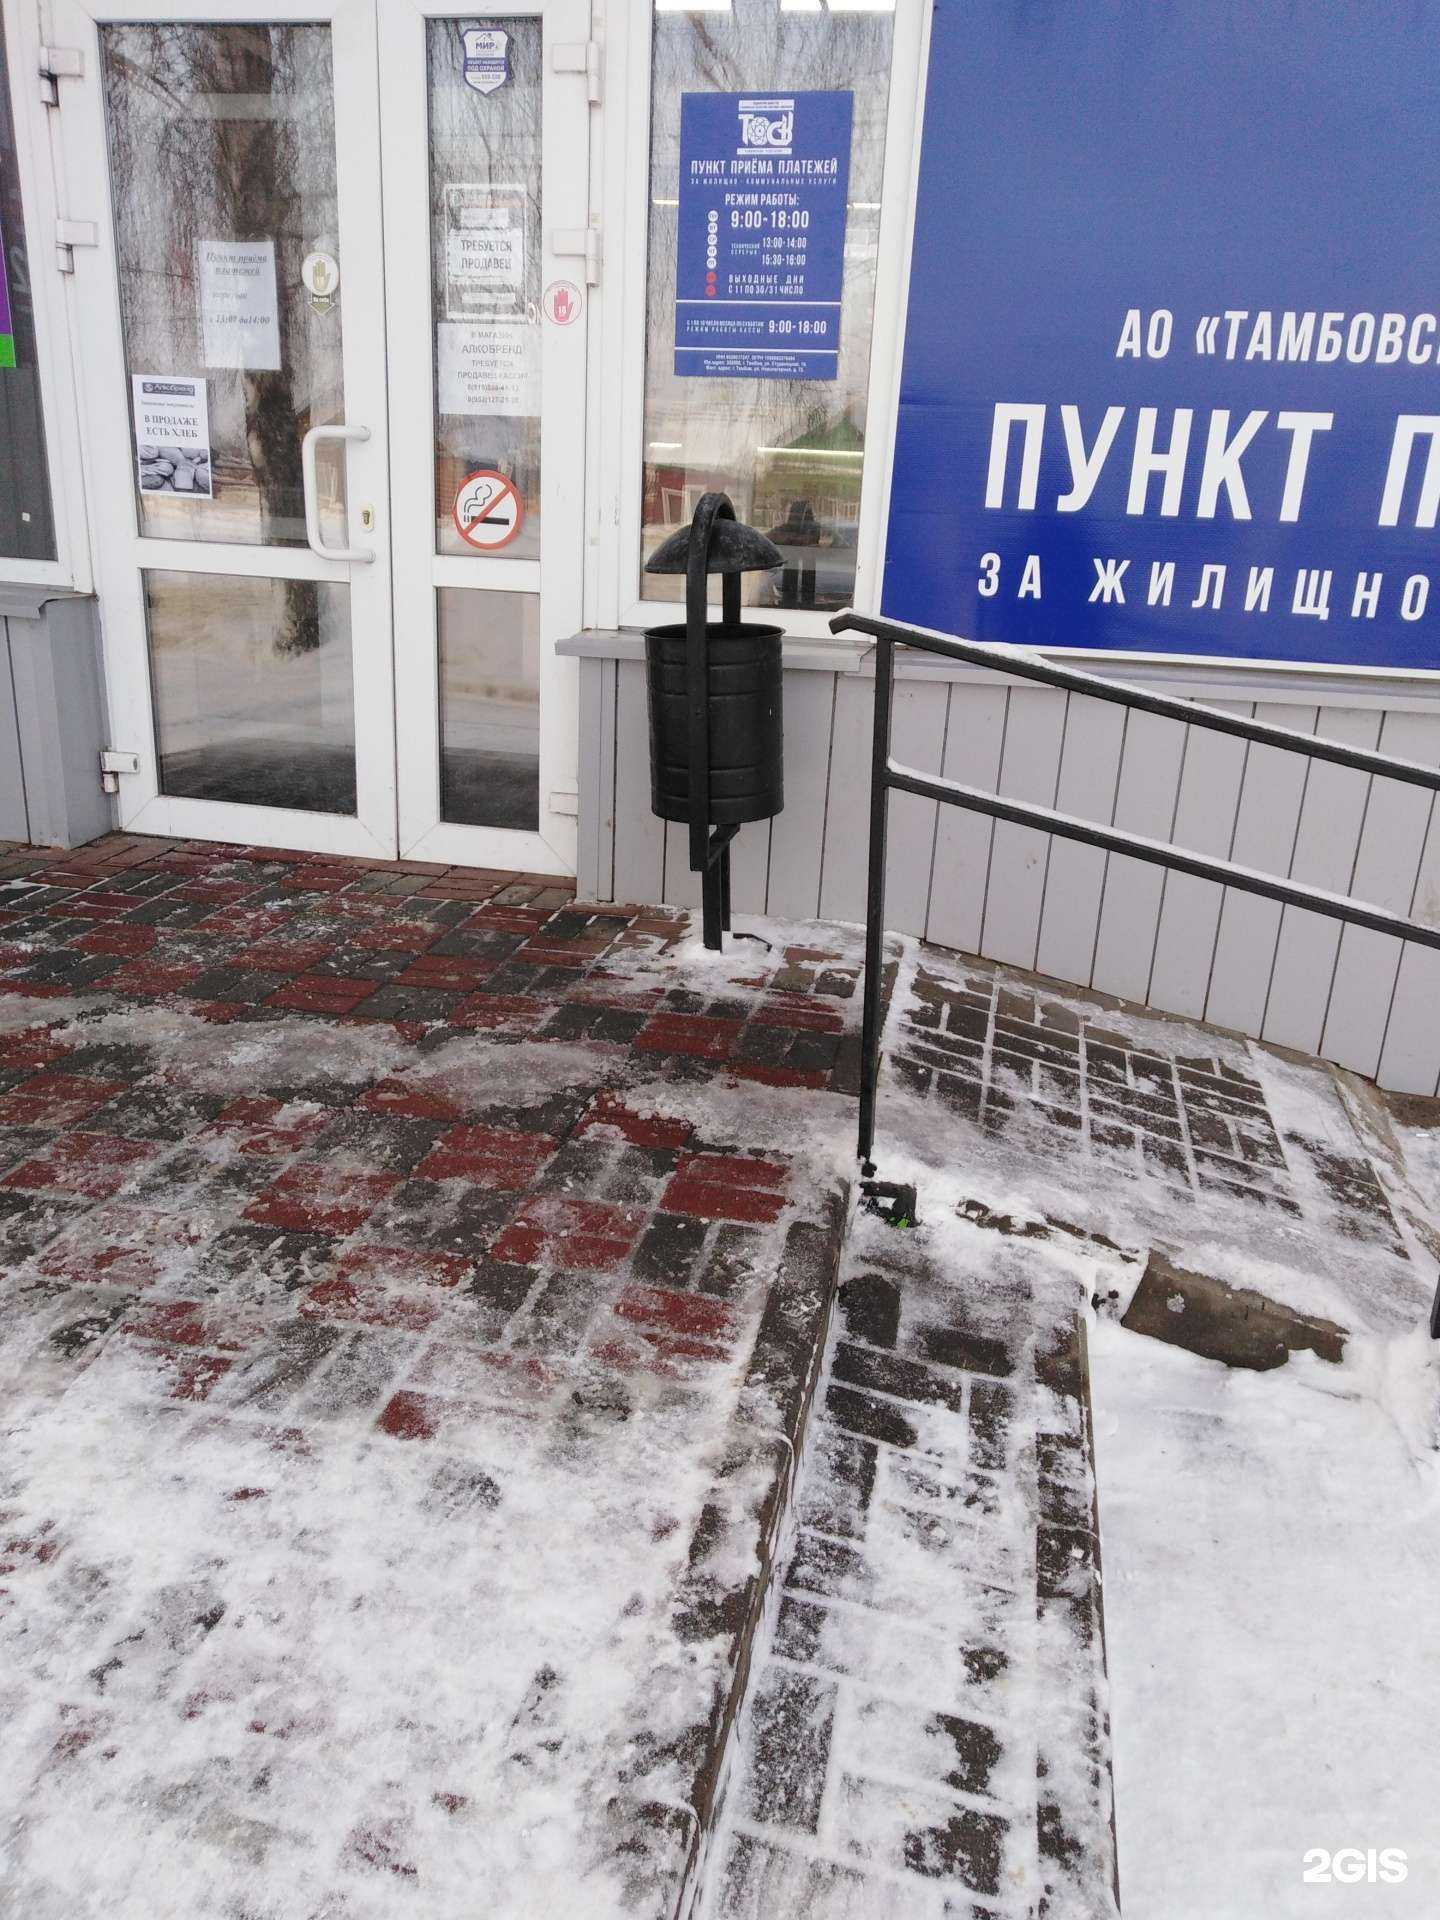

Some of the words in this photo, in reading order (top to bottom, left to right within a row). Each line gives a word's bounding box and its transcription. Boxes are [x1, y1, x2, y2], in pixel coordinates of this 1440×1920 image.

[691, 160, 725, 174] ПУНКТ
[731, 158, 773, 174] ПРИЁМА
[778, 158, 837, 174] ПЛАТЕЖЕЙ
[725, 193, 758, 205] РЕЖИМ
[760, 193, 800, 206] РАБОТЫ:
[731, 210, 809, 228] 9:00-18:00
[461, 239, 512, 252] ТРЕБУЕТСЯ
[762, 237, 807, 248] 13:00-14:00
[461, 258, 512, 271] ПРОДАВЕЦ
[728, 274, 778, 283] ВЫХОДНЫЕ
[786, 275, 804, 284] ДНИ
[779, 285, 804, 295] ЧИСЛО
[768, 320, 827, 334] 9:00-18:00
[1116, 309, 1174, 359] АО
[1195, 310, 1440, 365] «ТАМБОВС
[461, 344, 522, 354] АЛКОБРЕНД
[152, 415, 199, 426] ПРОДАЖЕ
[146, 427, 170, 436] ЕСТЬ
[172, 429, 198, 438] ХЛЕБ
[985, 403, 1334, 522] ПУНКТ
[977, 552, 1042, 600] ЗА
[1088, 558, 1430, 622] ЖИЛИЩНО
